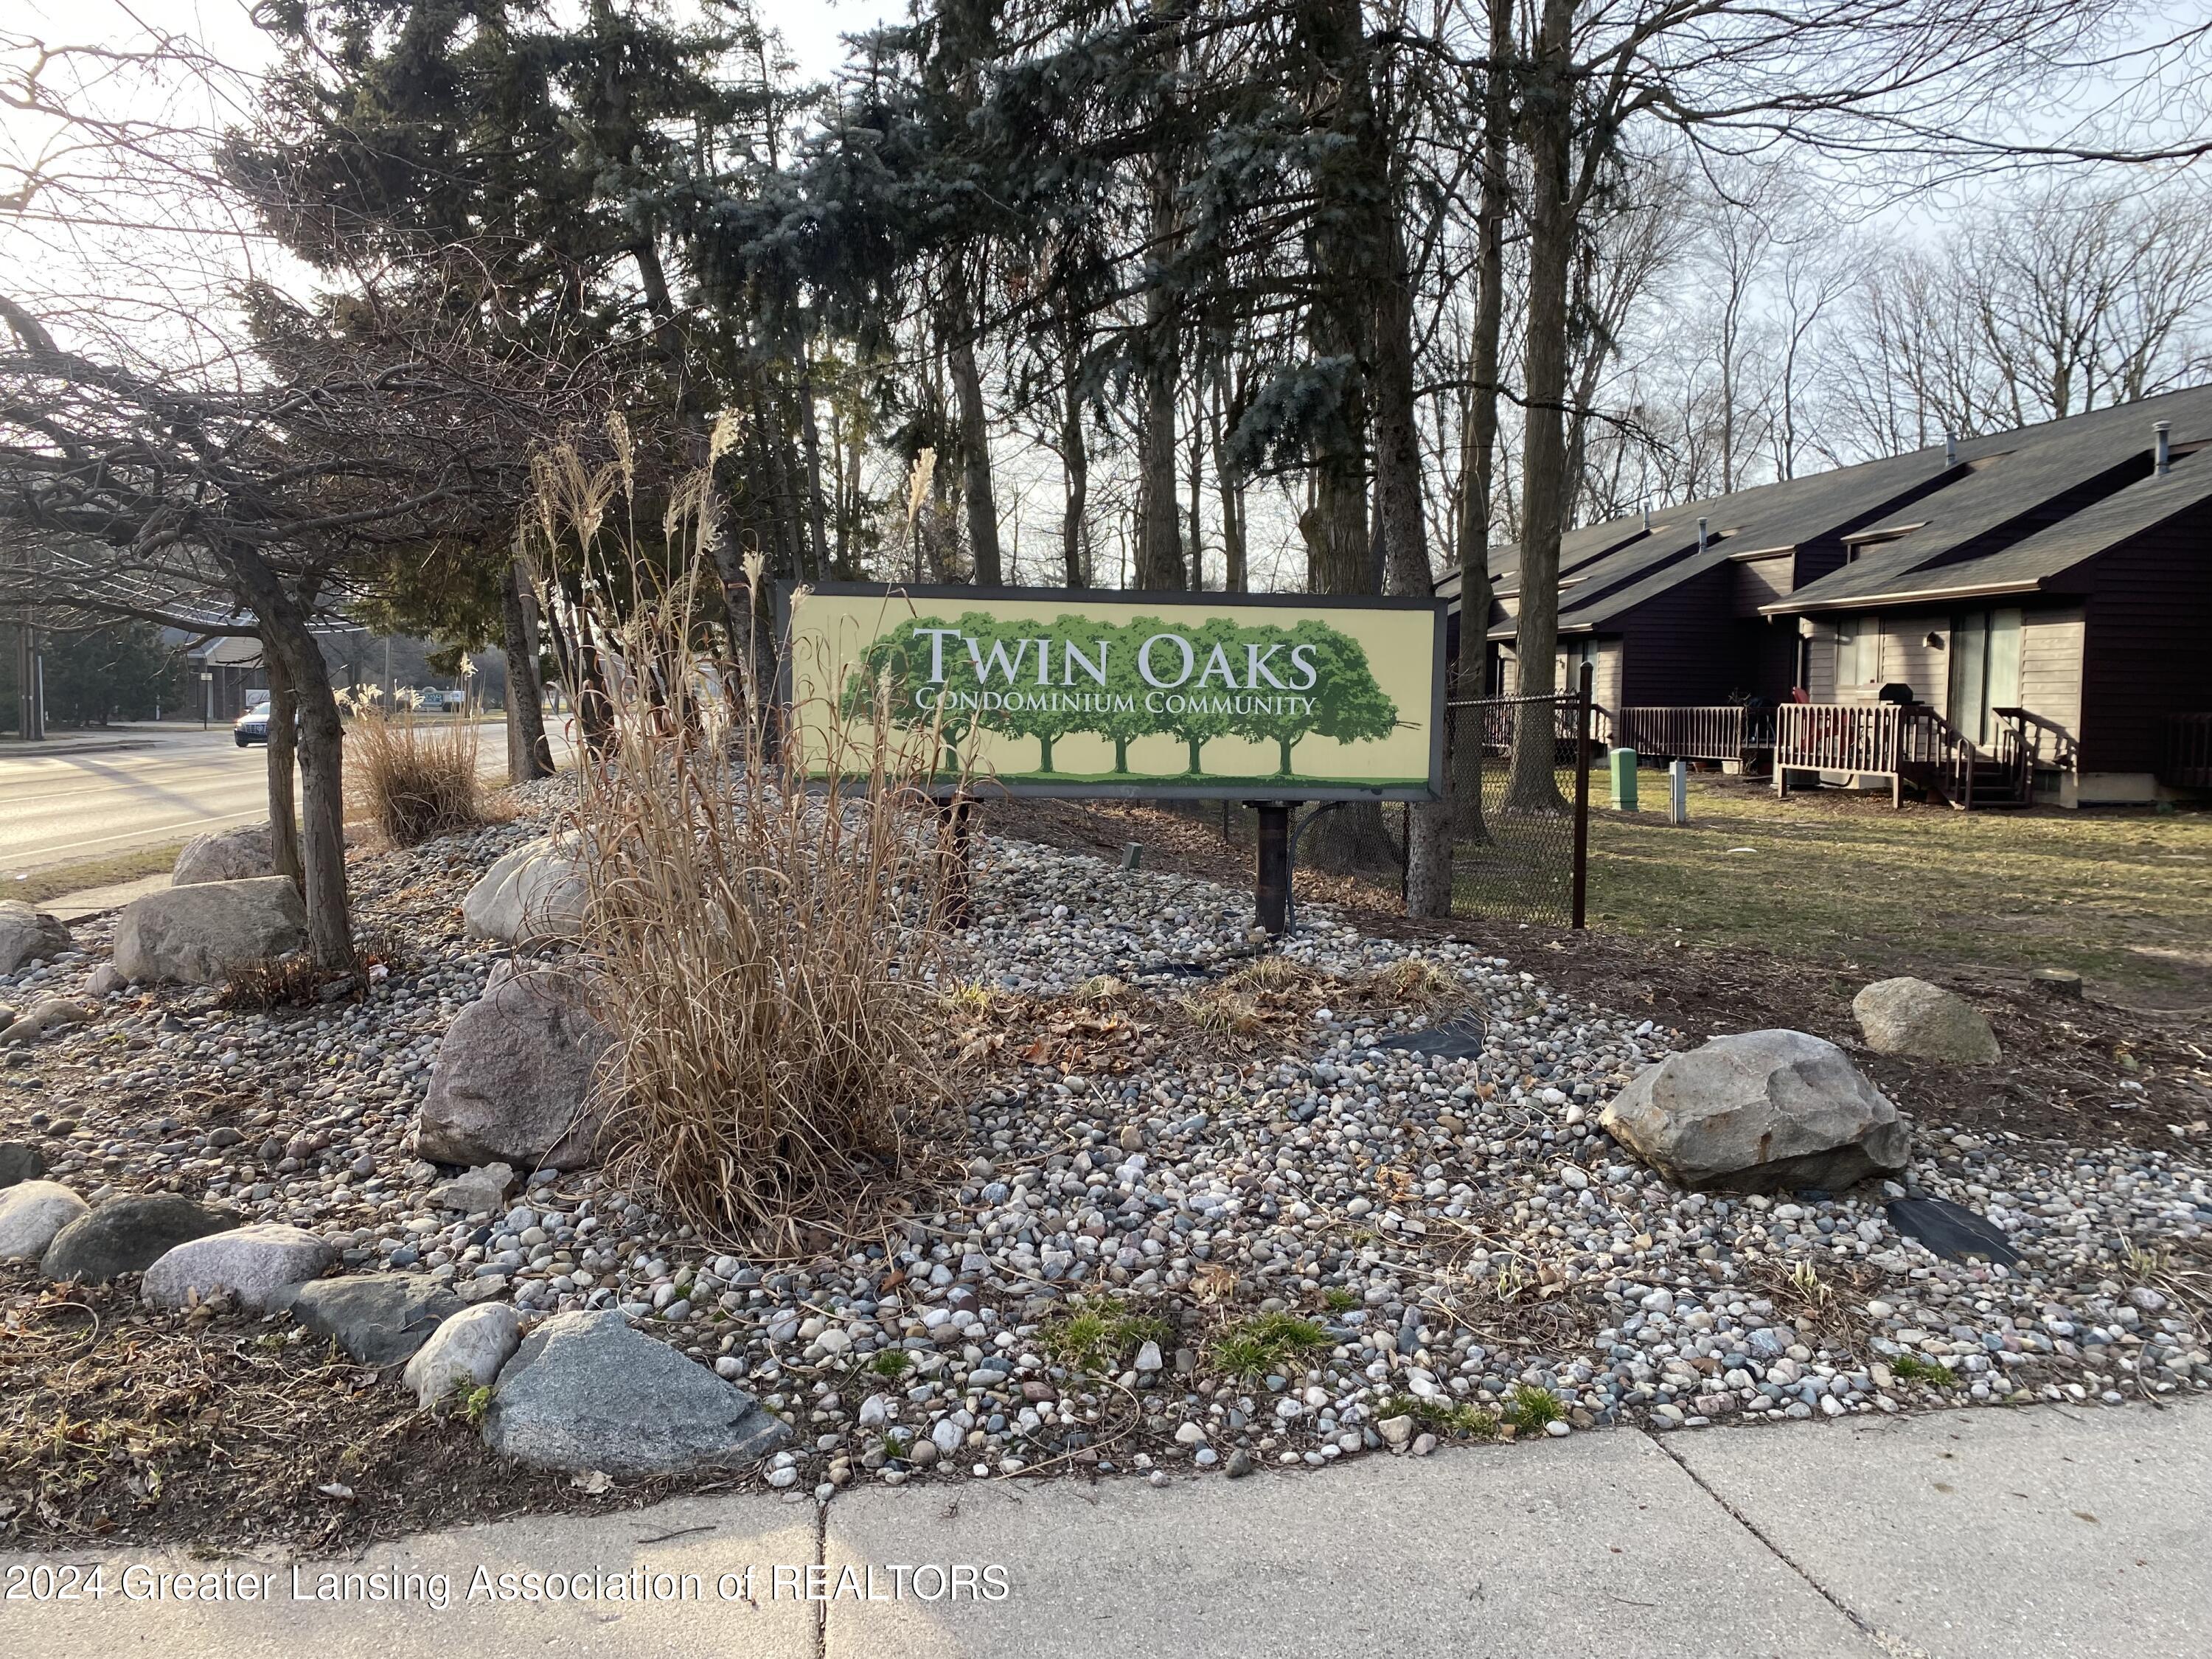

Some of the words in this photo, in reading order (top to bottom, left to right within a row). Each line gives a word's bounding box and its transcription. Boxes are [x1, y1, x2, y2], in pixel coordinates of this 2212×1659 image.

[913, 628, 1111, 686] TWIN
[1138, 633, 1317, 690] OAKS
[915, 687, 1135, 713] CONDOMINIUM
[1145, 692, 1317, 715] COMMUNITY
